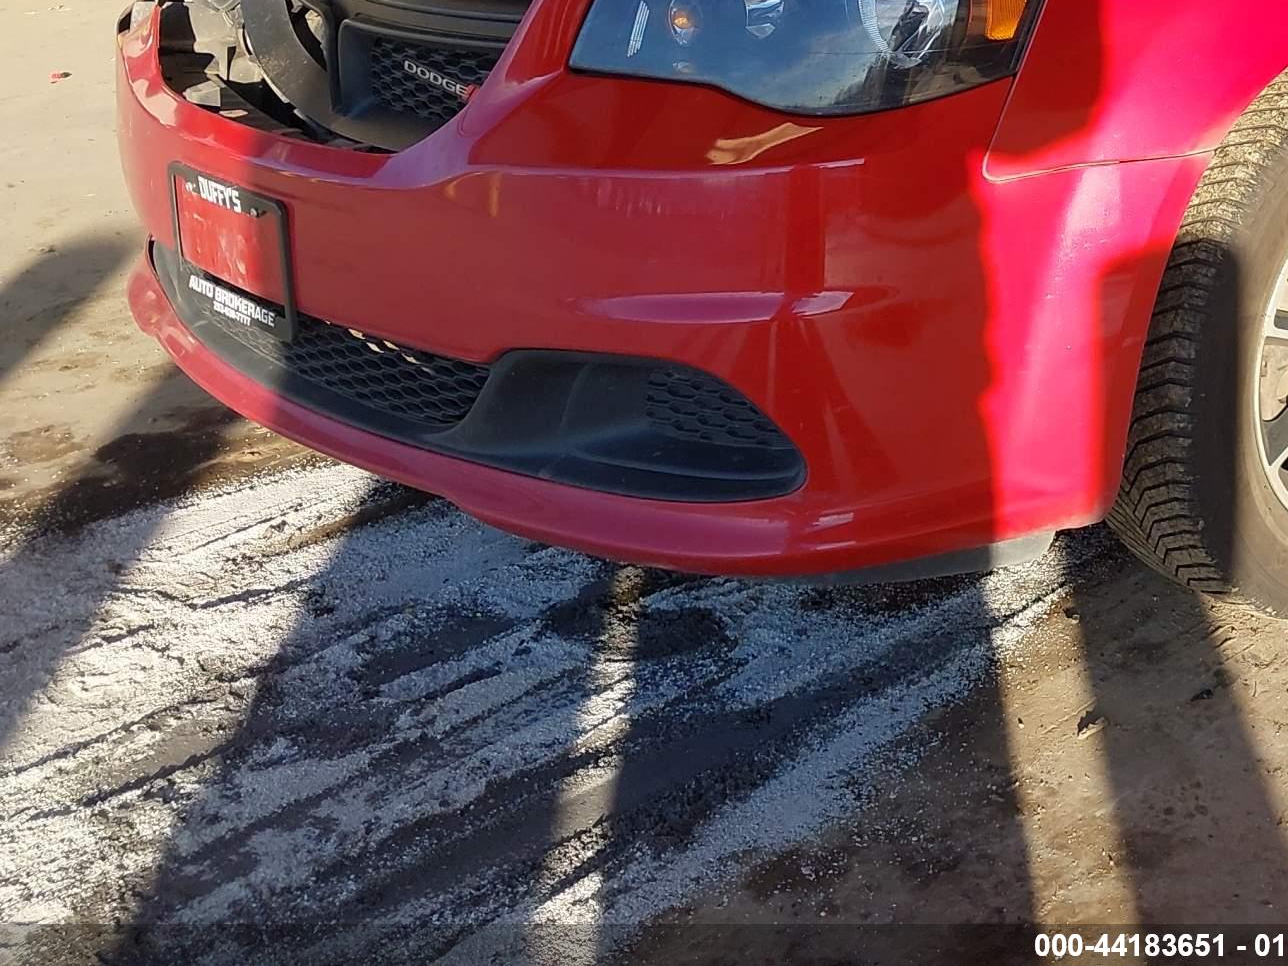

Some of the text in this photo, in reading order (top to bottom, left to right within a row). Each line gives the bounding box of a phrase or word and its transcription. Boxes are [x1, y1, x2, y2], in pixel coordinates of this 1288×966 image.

[403, 60, 469, 98] DODGE
[198, 176, 242, 214] DUFFY'S
[188, 275, 276, 328] AUTO BROKERAGE
